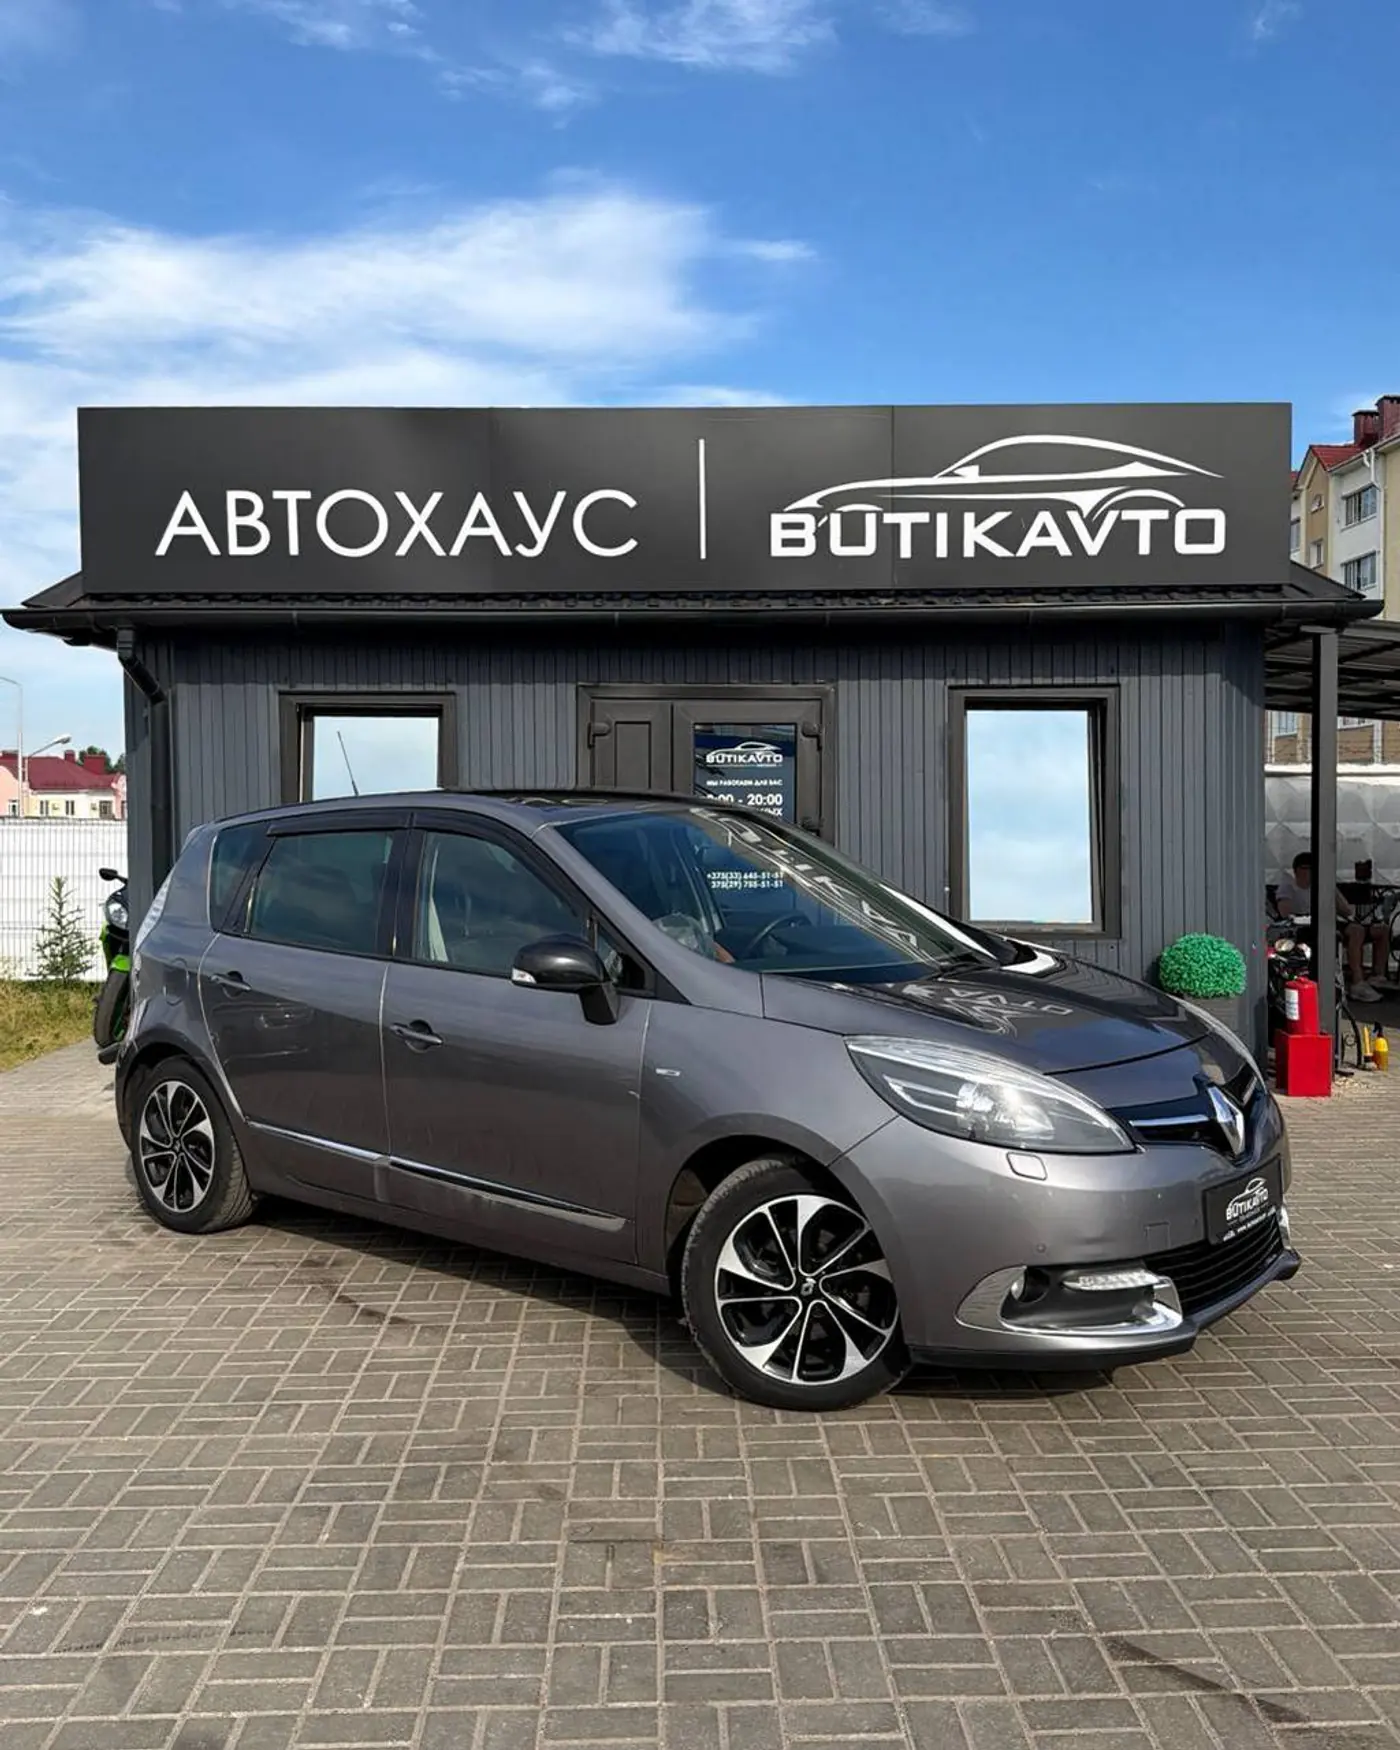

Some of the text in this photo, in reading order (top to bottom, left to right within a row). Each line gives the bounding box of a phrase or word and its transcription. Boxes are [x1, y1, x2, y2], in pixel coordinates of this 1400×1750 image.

[156, 490, 637, 557] АВТОХАУС
[770, 508, 1226, 558] BUTIKAVTO
[706, 753, 783, 764] BUTIKAVTO
[747, 793, 783, 806] 20:00
